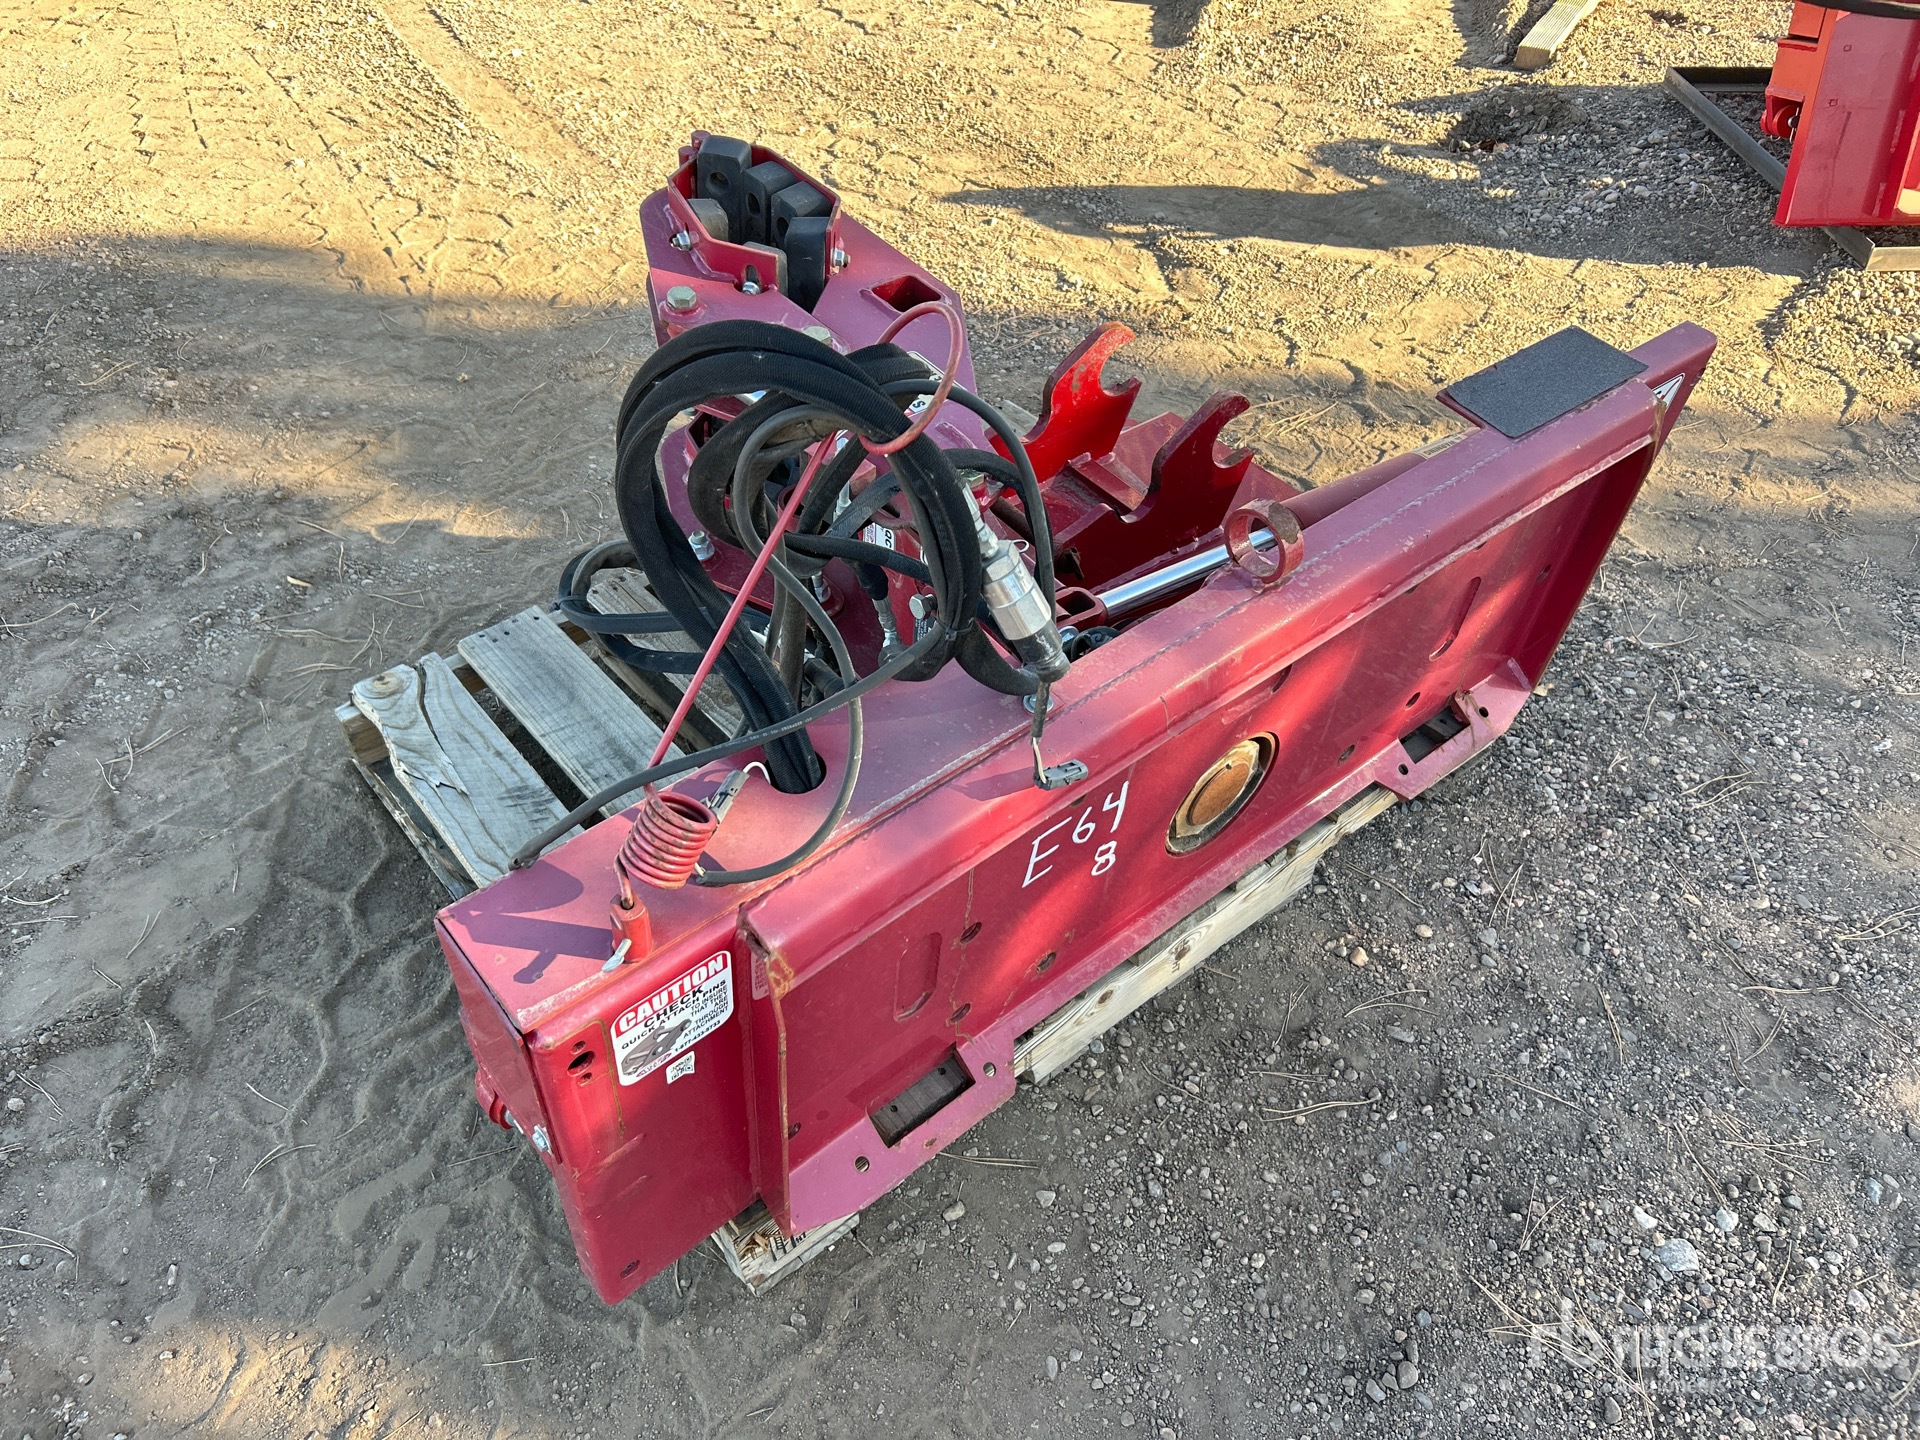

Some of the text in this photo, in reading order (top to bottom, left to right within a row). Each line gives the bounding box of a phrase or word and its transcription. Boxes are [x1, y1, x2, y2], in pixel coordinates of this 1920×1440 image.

[1091, 840, 1118, 876] 8
[618, 953, 724, 1033] CAUTION
[643, 985, 704, 1028] CHECK
[690, 985, 728, 1012] TO INSURE
[690, 991, 728, 1017] THAT THEY
[714, 996, 729, 1008] ARE
[621, 979, 726, 1050] QUICK ATTACH PINS
[683, 1006, 729, 1039] ATTACHMENT
[694, 1000, 729, 1025] THROUGH
